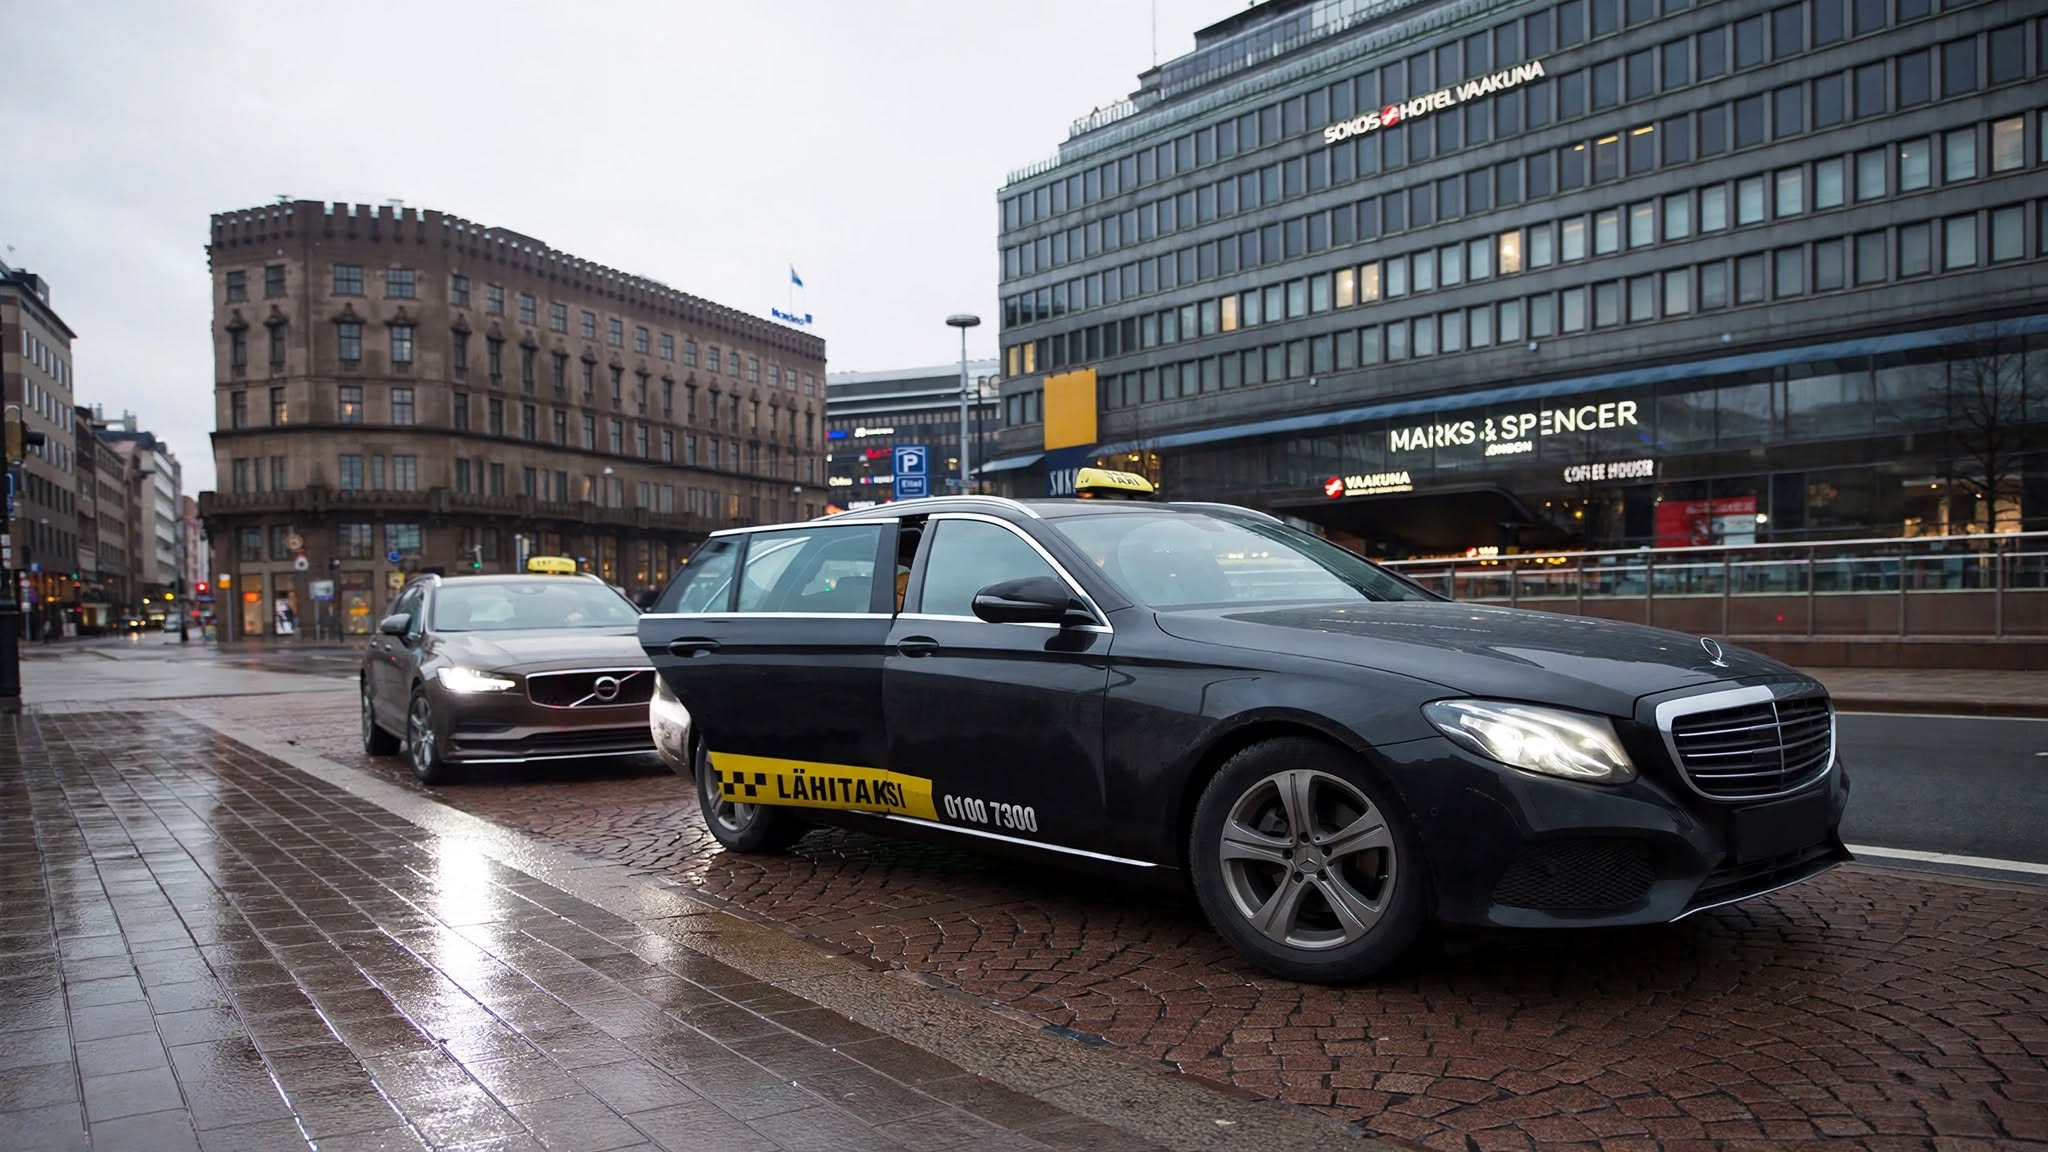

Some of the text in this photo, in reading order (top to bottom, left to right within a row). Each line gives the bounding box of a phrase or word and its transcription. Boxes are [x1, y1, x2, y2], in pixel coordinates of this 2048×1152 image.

[1324, 60, 1545, 144] SOKOS HOTEL VAAKUNA
[1390, 401, 1638, 452] MARKS & SPENCER
[903, 454, 918, 473] P
[1344, 471, 1411, 489] VAAKUNA
[776, 768, 907, 809] LÄHITAKSI
[944, 794, 1038, 832] 0100 7300
